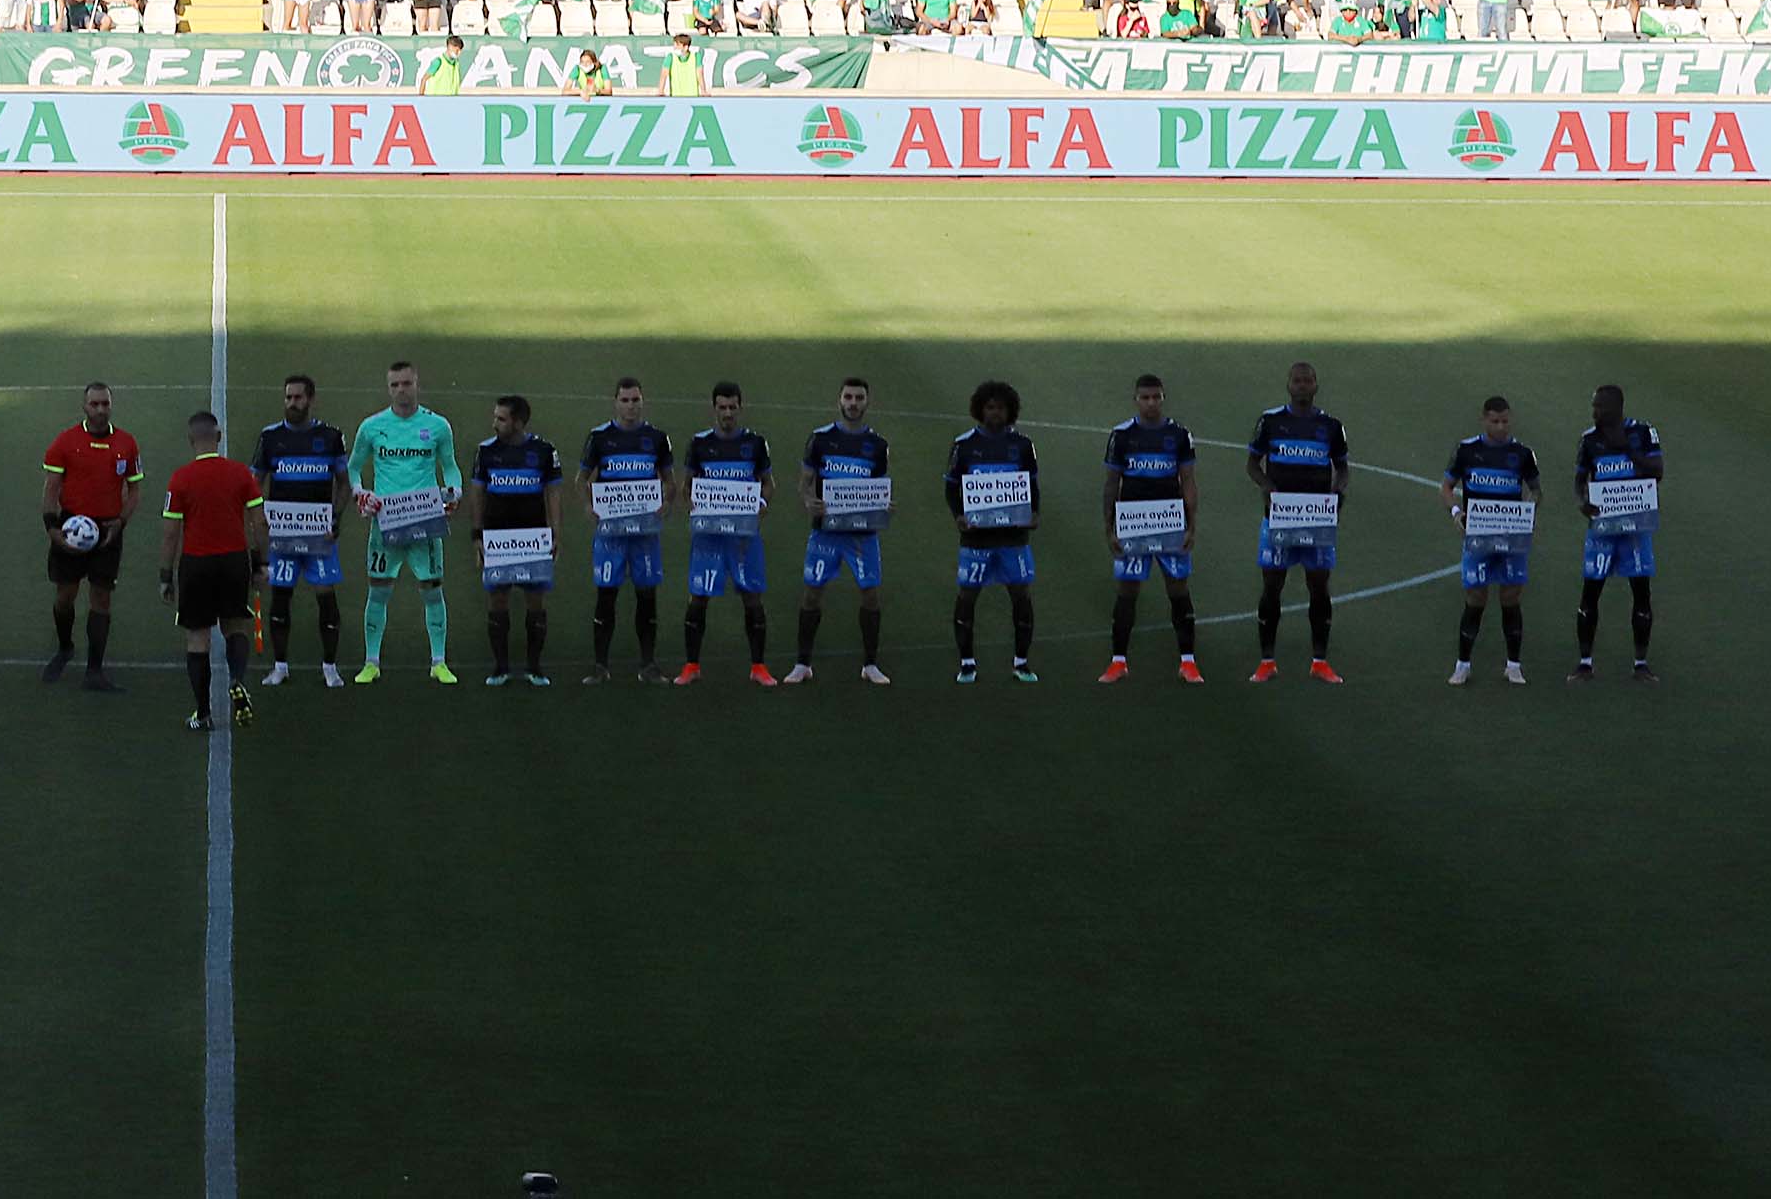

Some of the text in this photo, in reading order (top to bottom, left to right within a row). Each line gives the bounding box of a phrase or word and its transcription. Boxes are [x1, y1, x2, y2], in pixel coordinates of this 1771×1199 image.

[27, 47, 309, 87] GREEN
[212, 104, 736, 168] ALFA PIZZA
[891, 107, 1405, 171] ALFA PIZZA
[1544, 111, 1757, 173] ALFA
[275, 460, 330, 474] Stoiximan
[965, 479, 1027, 492] Give hope
[1601, 484, 1644, 496] Αναδοχή
[414, 492, 430, 503] την
[595, 493, 659, 505] καρδιά σου
[695, 491, 757, 503] το μεγαλείο
[833, 491, 880, 502] δικαίωμα
[967, 492, 1028, 504] to a child
[1603, 494, 1643, 504] σημαίνει
[1272, 503, 1335, 514] Every Child
[1470, 503, 1522, 516] Αναδοχή
[295, 509, 329, 522] σπίτι
[1119, 510, 1182, 522] Δώσε αγάπη
[486, 539, 540, 551] Αναδοχή
[370, 551, 387, 573] 26
